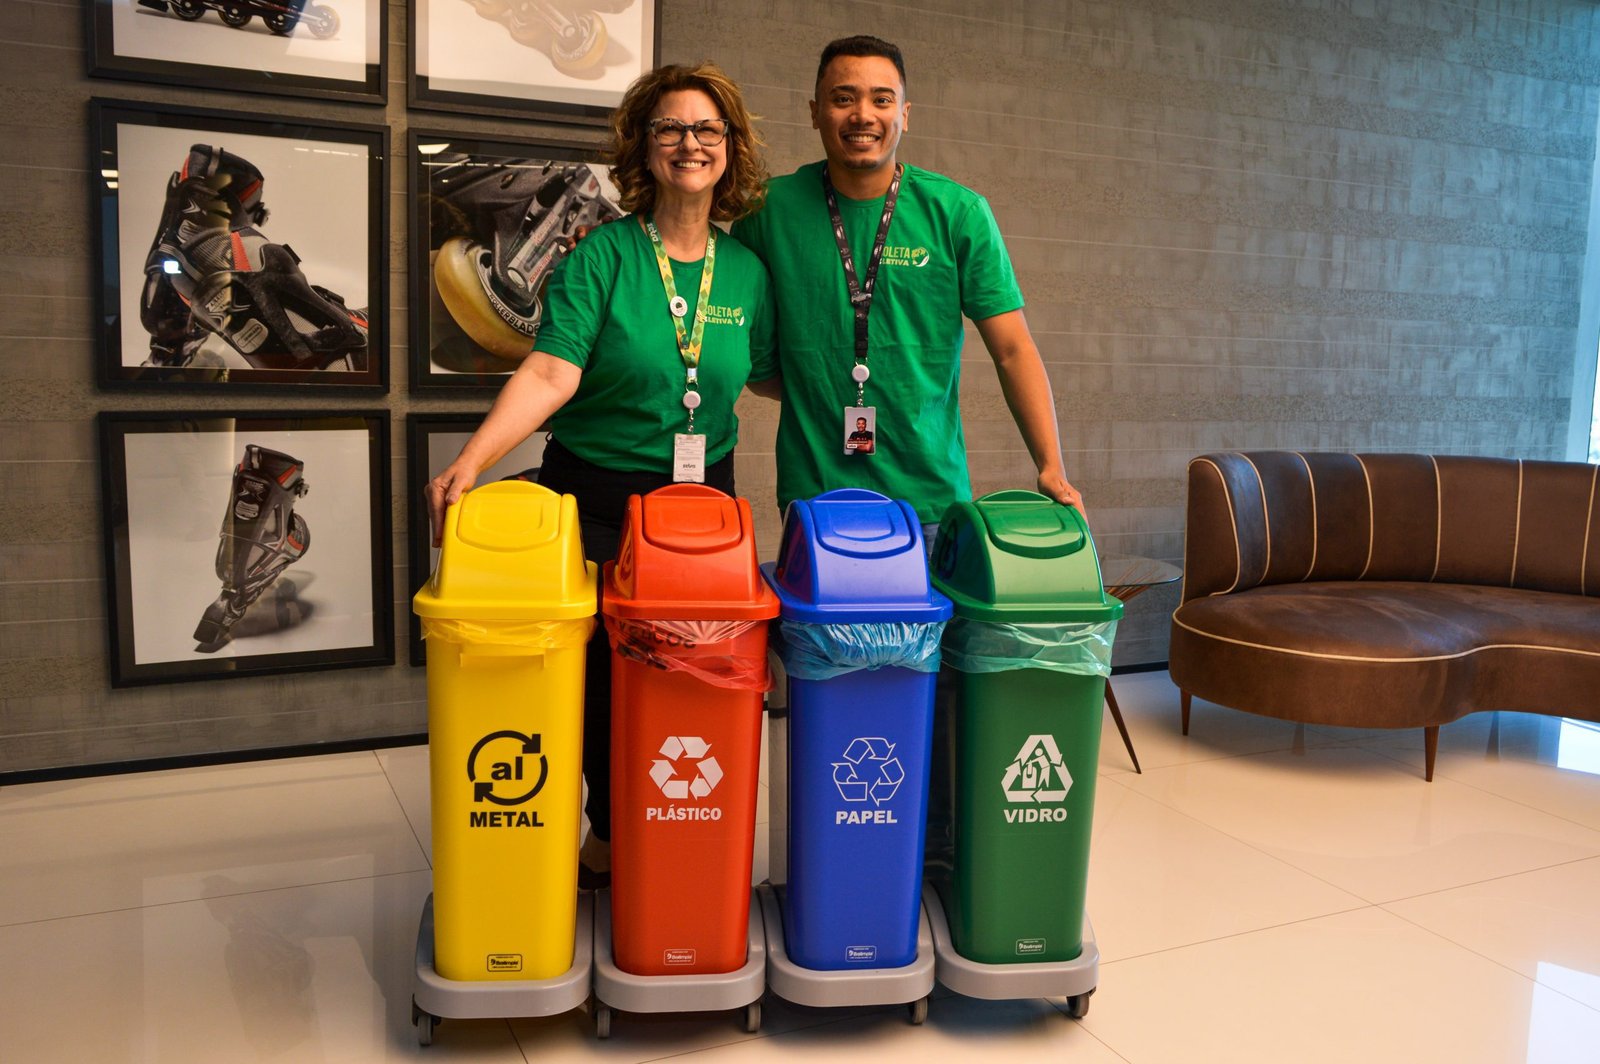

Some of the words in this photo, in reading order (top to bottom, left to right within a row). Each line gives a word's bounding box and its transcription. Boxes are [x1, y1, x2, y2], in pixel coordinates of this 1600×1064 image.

[883, 246, 910, 258] OLETA
[707, 305, 732, 317] OLETA
[491, 756, 523, 780] al
[470, 811, 544, 828] METAL
[646, 804, 722, 821] PLÁSTICO
[835, 810, 898, 825] PAPEL
[1003, 808, 1067, 823] VIDRO
